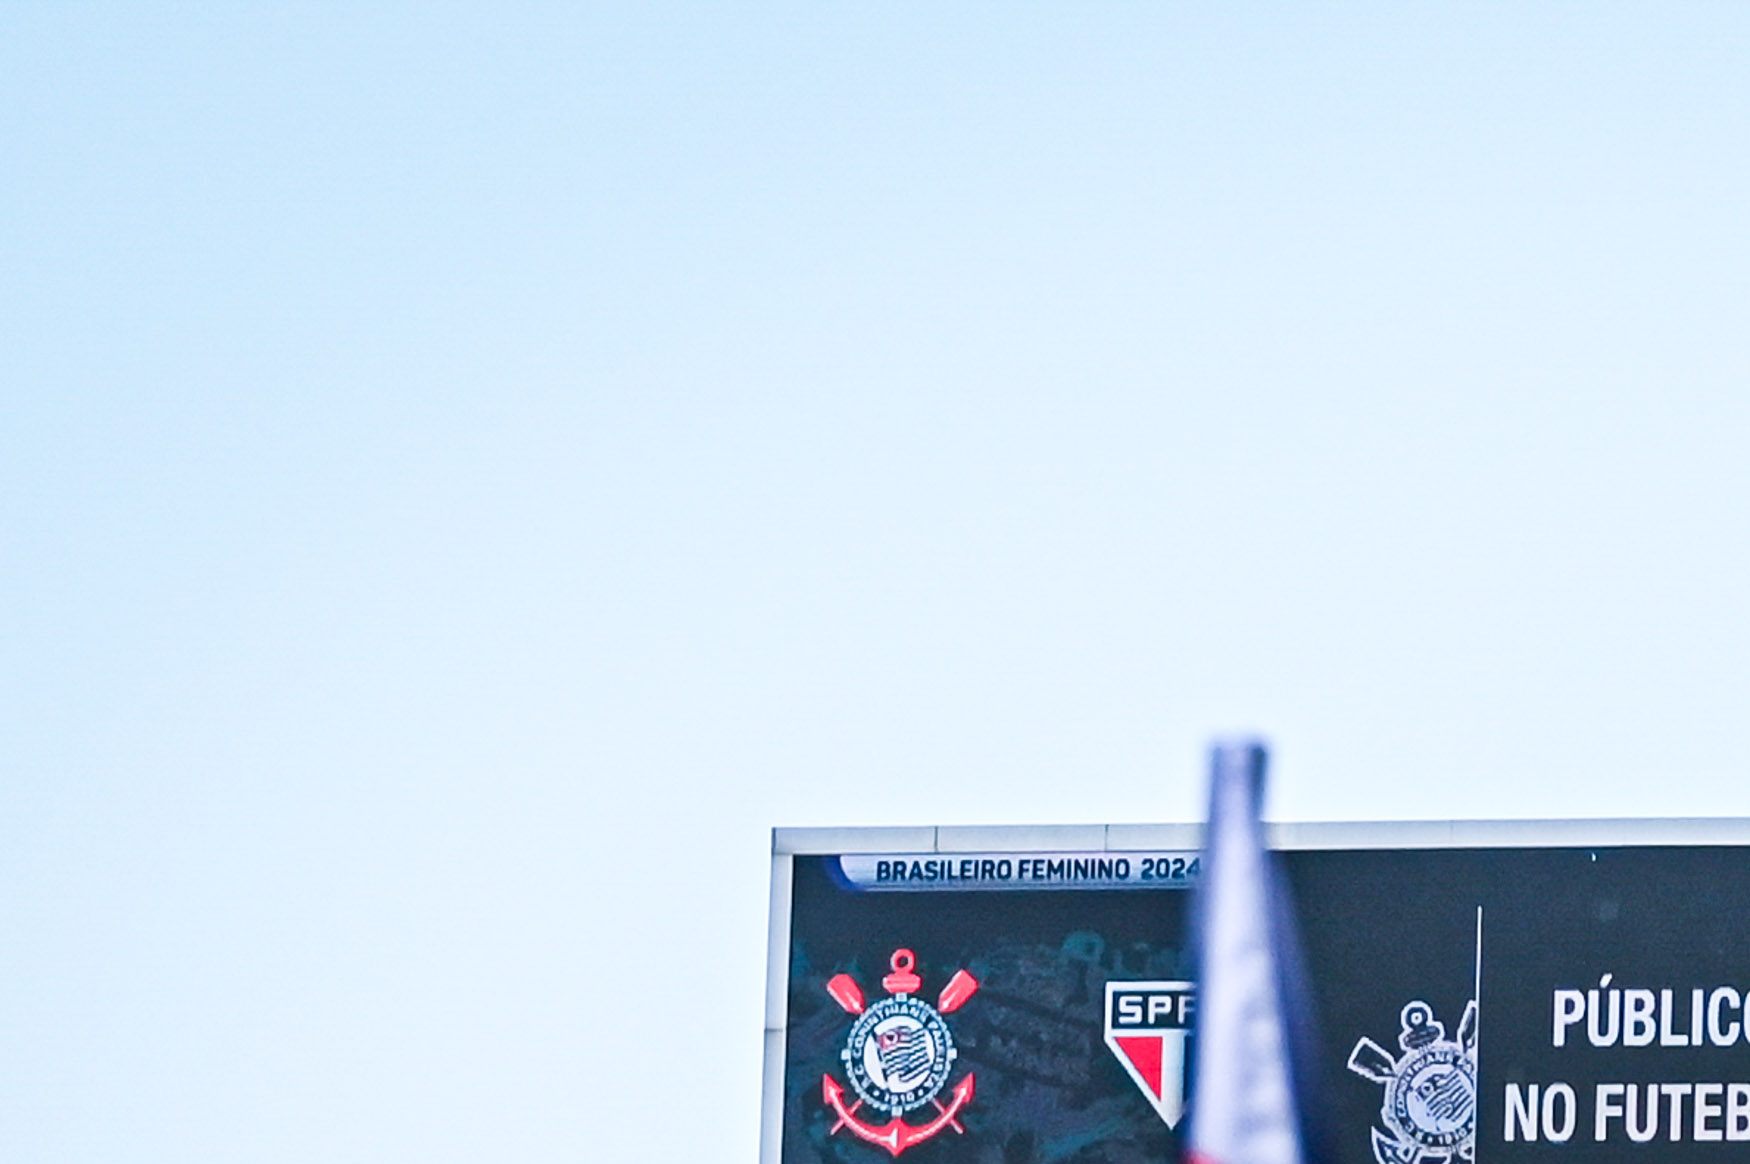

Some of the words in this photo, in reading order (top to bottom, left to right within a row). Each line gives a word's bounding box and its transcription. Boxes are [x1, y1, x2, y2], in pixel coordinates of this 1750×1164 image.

[876, 859, 1012, 882] BRASILEIRO
[1017, 858, 1131, 881] FEMININO
[1140, 857, 1200, 880] 2024
[1504, 1082, 1576, 1143] NO
